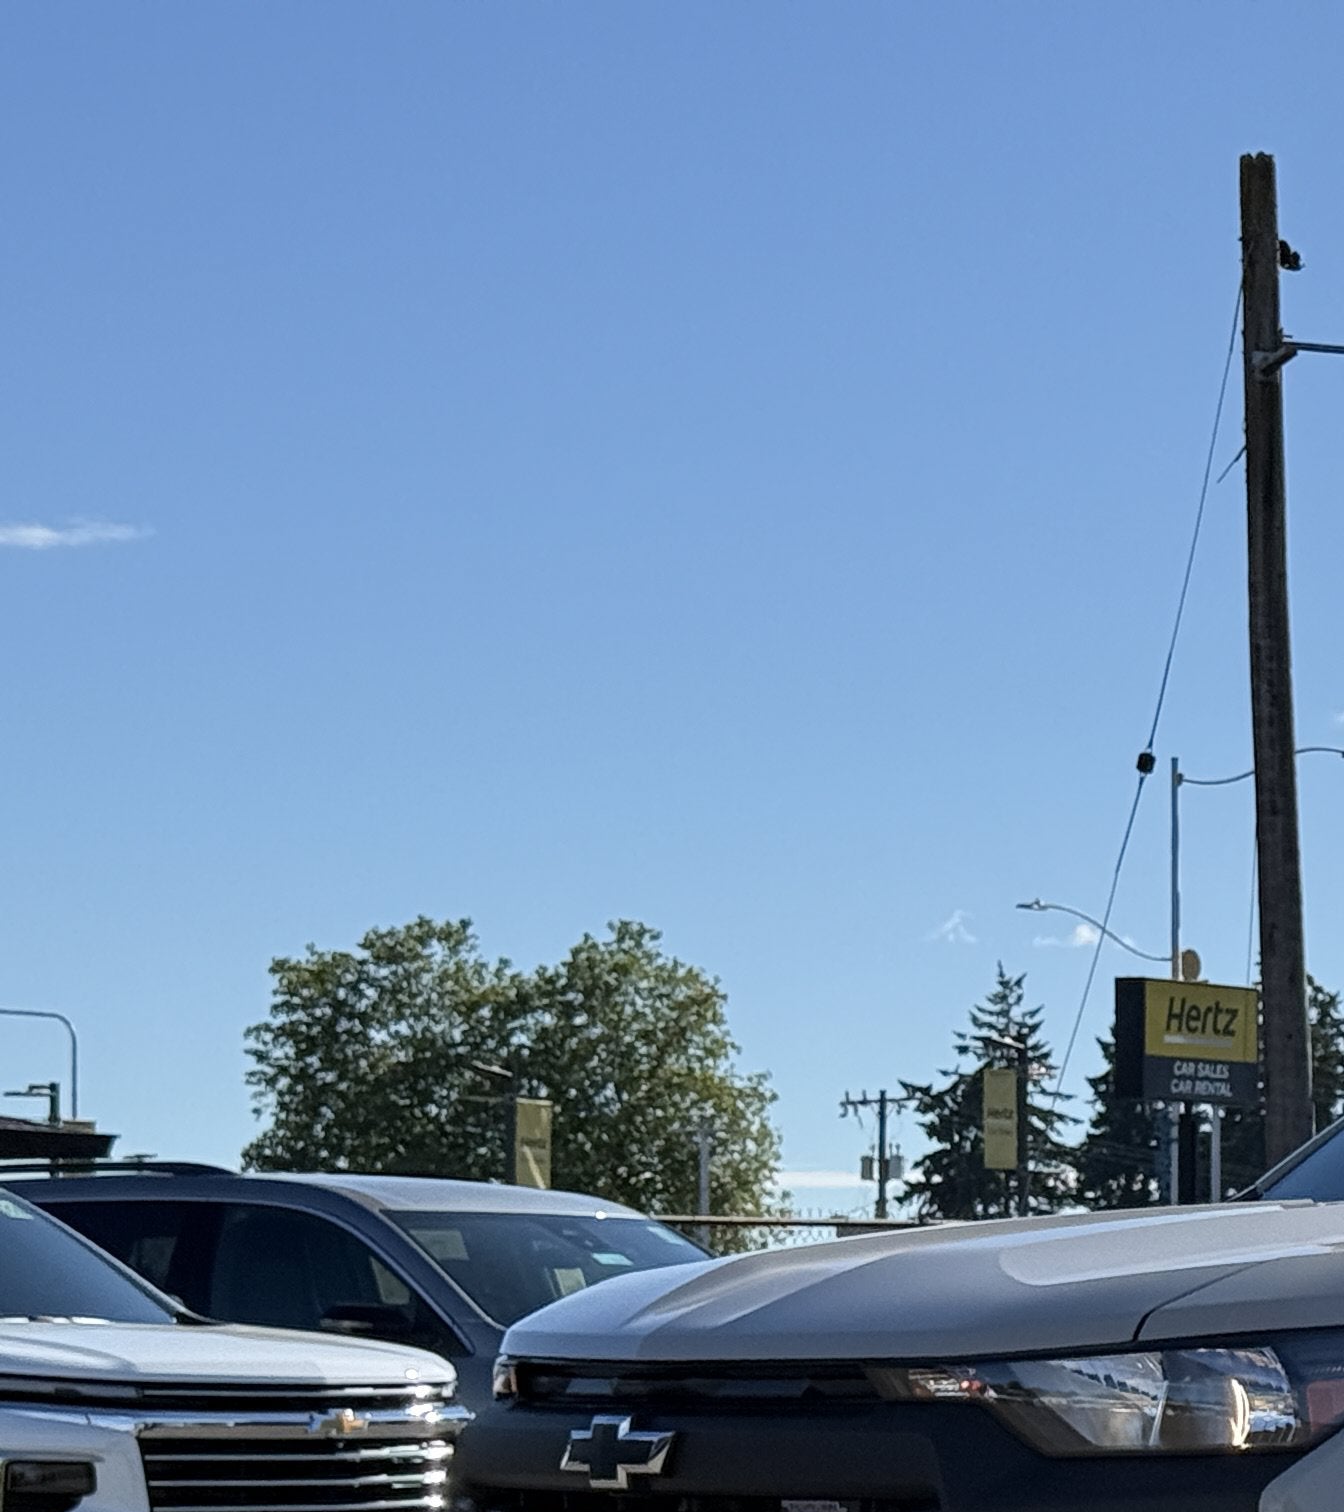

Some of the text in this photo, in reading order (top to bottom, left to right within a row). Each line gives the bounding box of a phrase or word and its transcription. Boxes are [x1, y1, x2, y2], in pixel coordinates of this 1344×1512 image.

[1166, 996, 1239, 1037] Hertz
[1174, 1060, 1229, 1079] CAR SALES
[1170, 1078, 1233, 1097] CAR RENTAL
